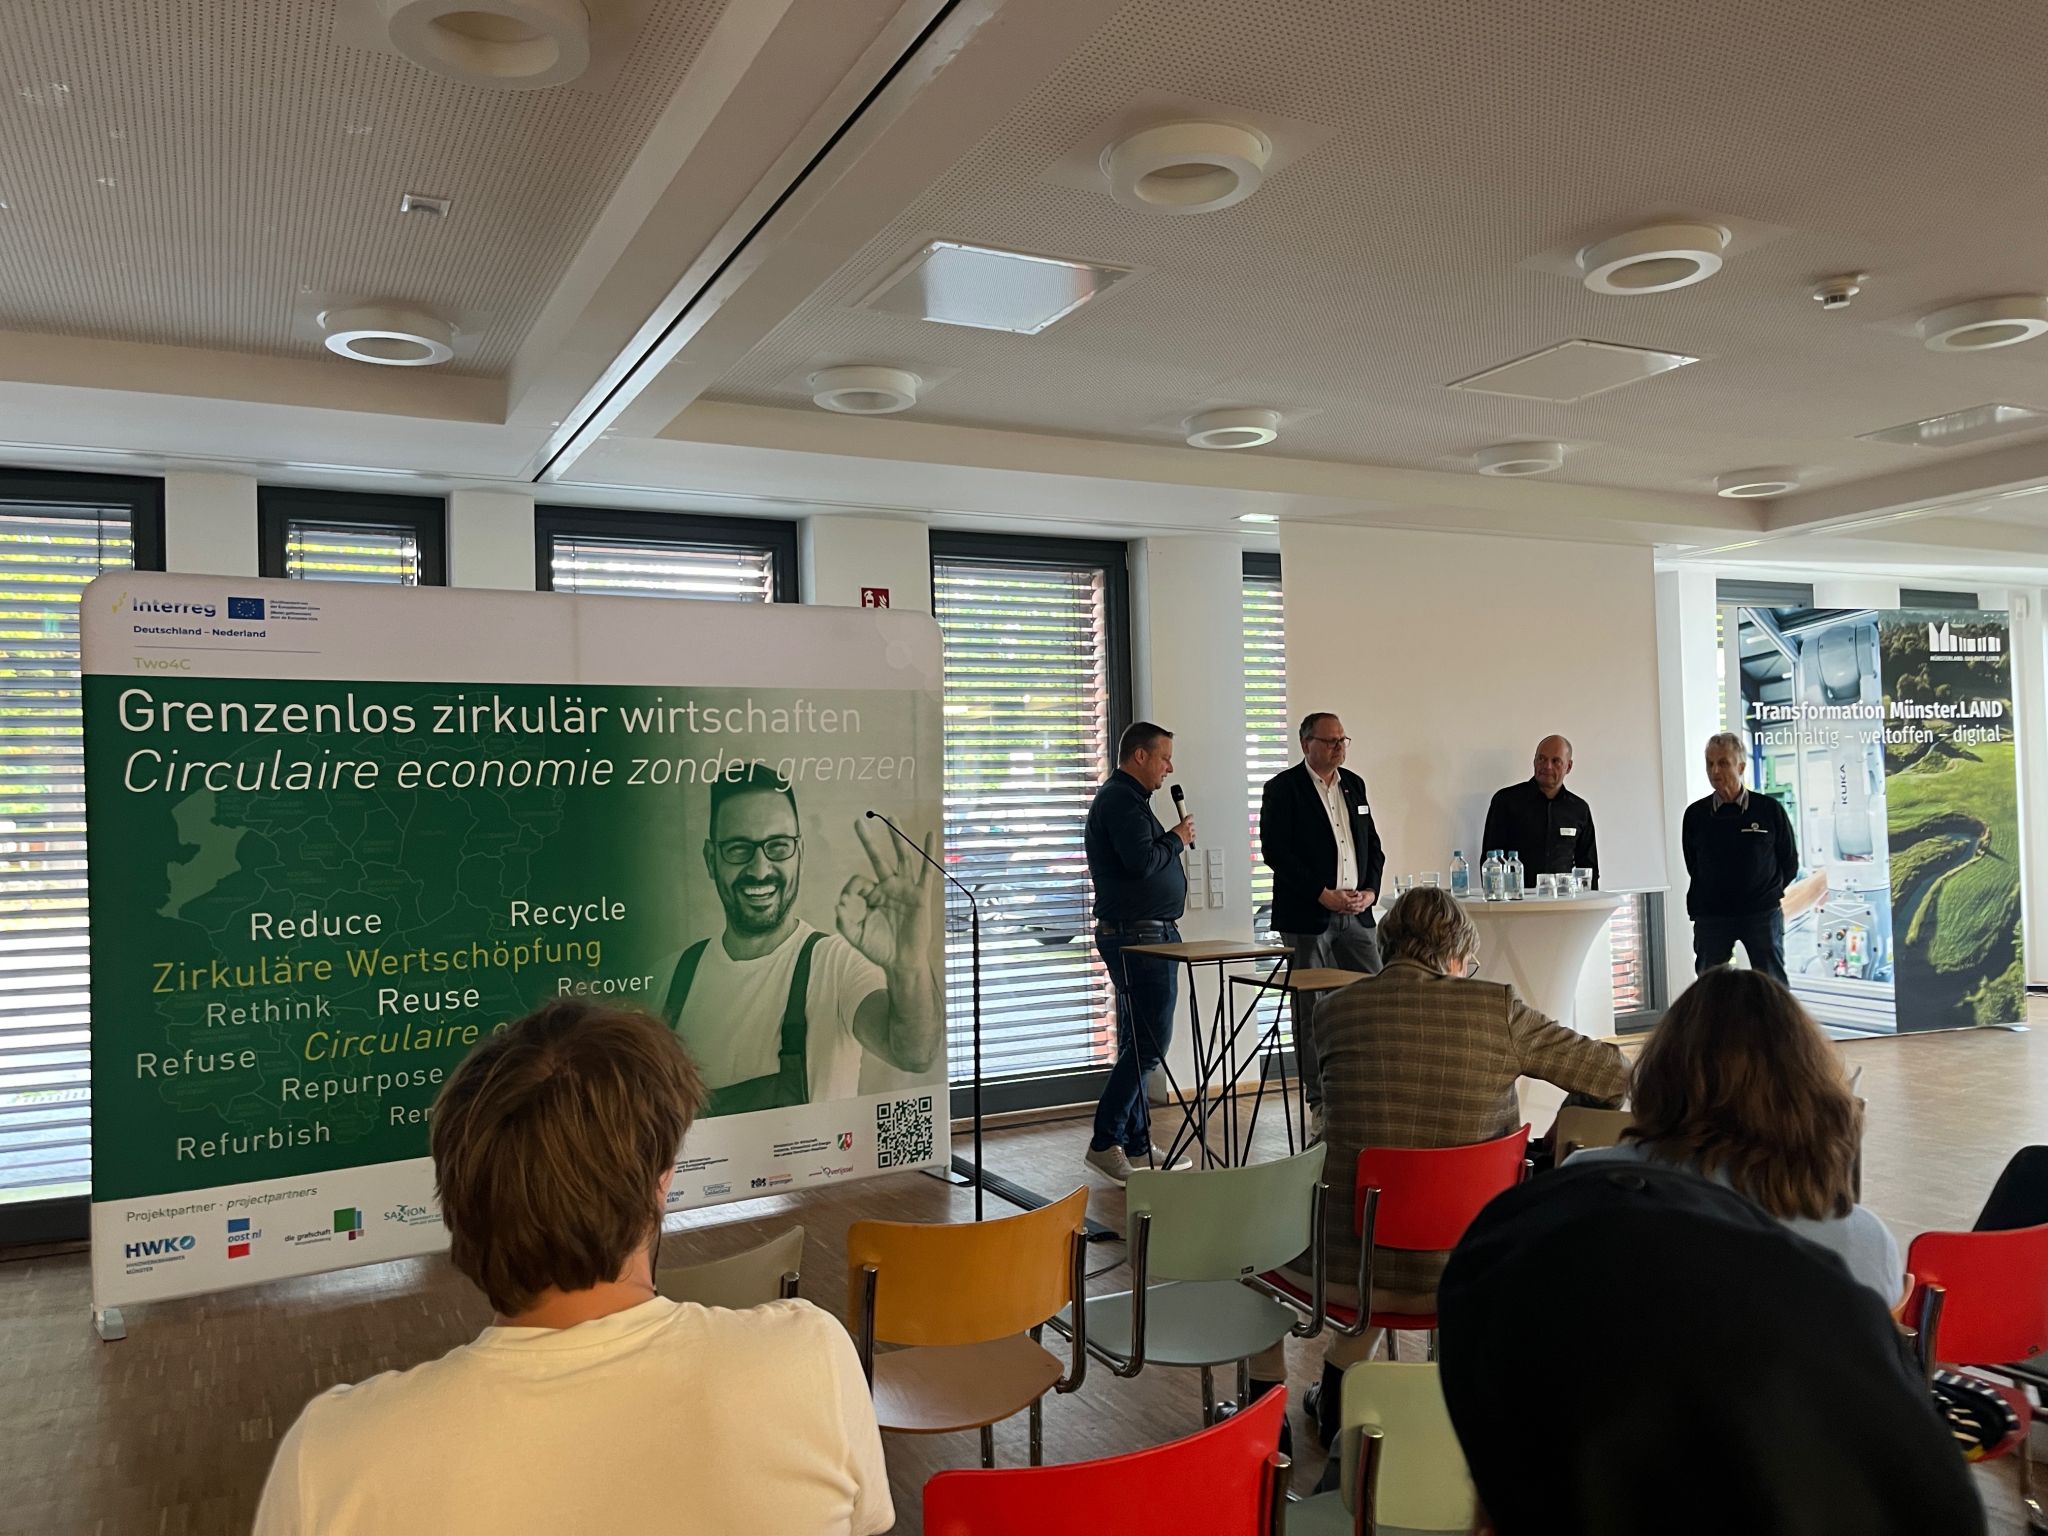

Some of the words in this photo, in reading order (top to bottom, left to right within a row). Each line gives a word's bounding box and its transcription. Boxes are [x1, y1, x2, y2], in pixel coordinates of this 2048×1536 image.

[133, 597, 216, 617] Interreg
[133, 625, 202, 636] Deutschland
[212, 628, 266, 638] Nederland
[133, 656, 191, 670] Two4C
[118, 688, 416, 733] Grenzenlos
[432, 694, 608, 734] zirkulär
[620, 697, 861, 734] wirtschaften
[1752, 701, 1885, 720] Transformation
[1890, 700, 2003, 720] Münster.LAND
[1754, 726, 1840, 748] nachhaltig
[1859, 725, 1934, 743] weltoffen
[1953, 724, 2001, 747] digital
[124, 748, 379, 793] Circulaire
[398, 748, 614, 789] economie
[627, 748, 767, 786] zonder
[775, 753, 917, 793] grenzen
[1839, 764, 1848, 805] KUKA
[250, 909, 383, 941] Reduce
[511, 896, 627, 931] Recycle
[152, 955, 333, 994] Zirkuläre
[346, 936, 602, 979] Wertschöpfung
[378, 987, 480, 1017] Reuse
[557, 974, 654, 998] Recover
[207, 996, 332, 1028] Rethink
[304, 1020, 479, 1062] Circulaire
[137, 1048, 257, 1080] Refuse
[282, 1066, 444, 1103] Repurpose
[176, 1121, 332, 1161] Refurbish
[127, 1202, 216, 1223] Projektpartner
[227, 1187, 318, 1210] projectpartners
